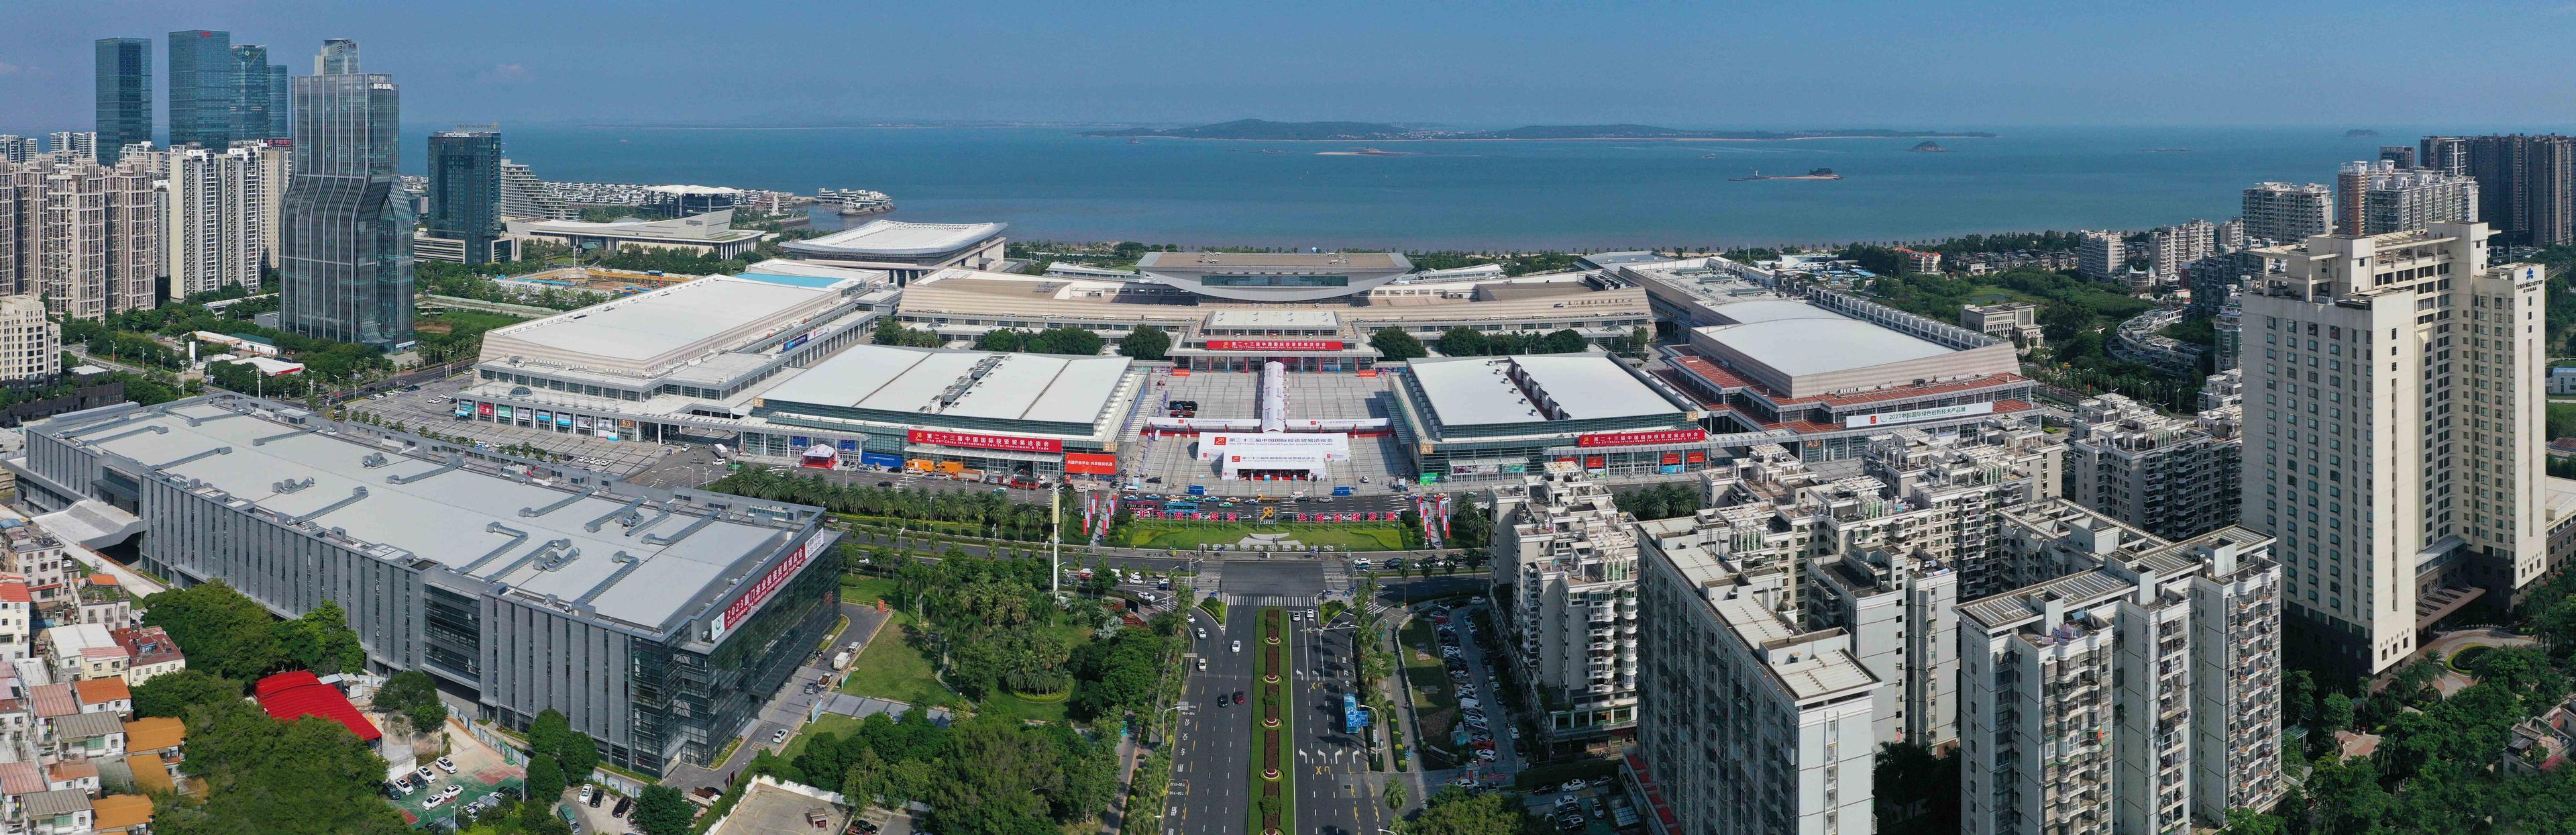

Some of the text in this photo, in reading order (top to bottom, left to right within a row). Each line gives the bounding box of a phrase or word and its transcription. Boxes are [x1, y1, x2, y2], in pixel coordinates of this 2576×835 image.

[1889, 407, 1966, 420] 2023中国国际绿色创新技术产品展
[927, 433, 1049, 447] 第二十三届中国国际投资贸易洽谈会
[1594, 432, 1698, 441] 第二十三届中国国际投资贸易洽谈会
[1140, 511, 1236, 522] 扩大双向投资
[1298, 512, 1395, 523] 共促全球发展
[728, 548, 802, 620] 2023厦门茶业投资贸易博览会
